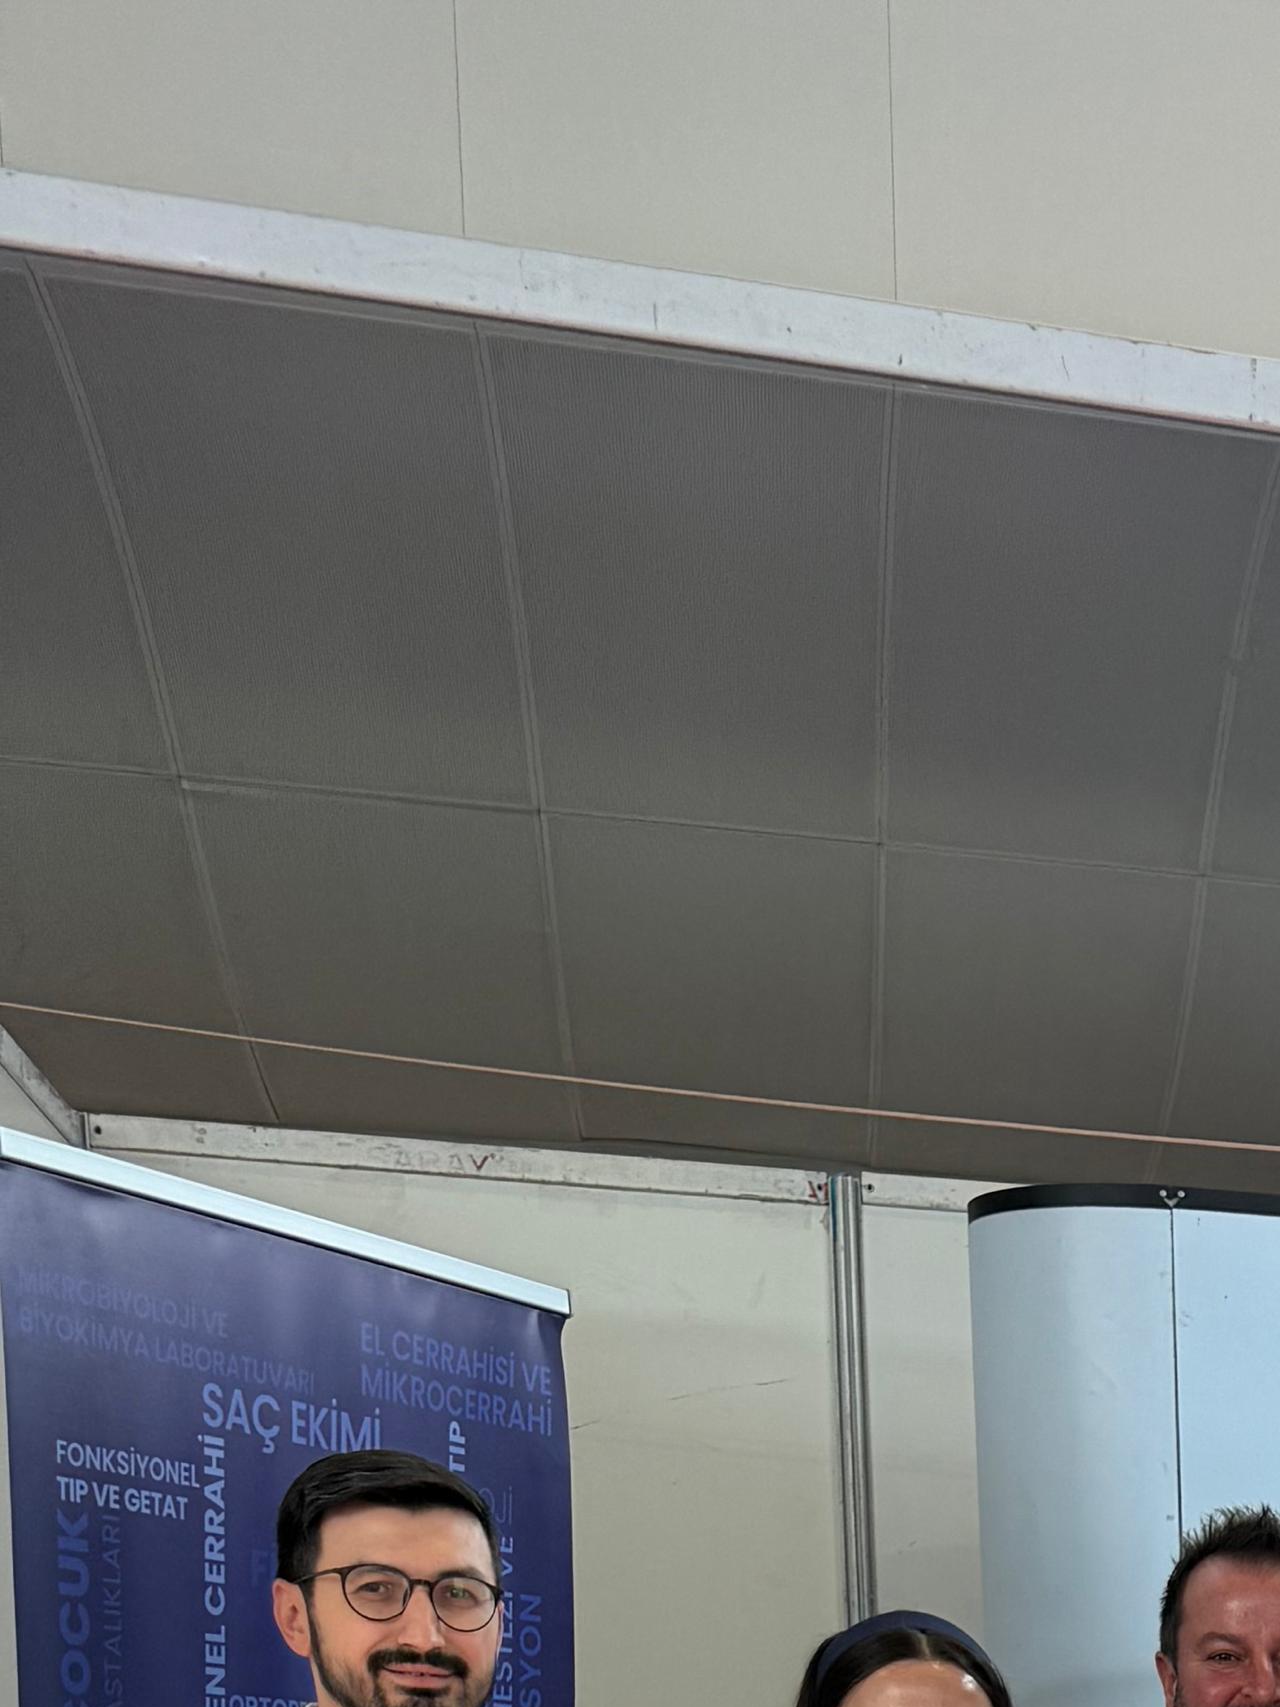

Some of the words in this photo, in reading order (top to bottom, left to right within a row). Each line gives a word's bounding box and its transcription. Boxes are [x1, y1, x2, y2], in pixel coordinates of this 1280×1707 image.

[202, 1310, 230, 1339] VE
[155, 1342, 315, 1396] LABORATUVARI
[360, 1321, 385, 1356] EL
[392, 1330, 515, 1389] CERRAHİSİ
[521, 1363, 552, 1396] VE
[202, 1382, 280, 1455] SAÇ
[290, 1397, 382, 1454] EKİMİ
[360, 1362, 552, 1438] MİKROCERRAHİ
[56, 1438, 200, 1489] FONKSİYONEL
[56, 1475, 89, 1504] TIP
[92, 1481, 121, 1511] VE
[124, 1488, 189, 1521] GETAT
[197, 1434, 226, 1617] CERRAHİ
